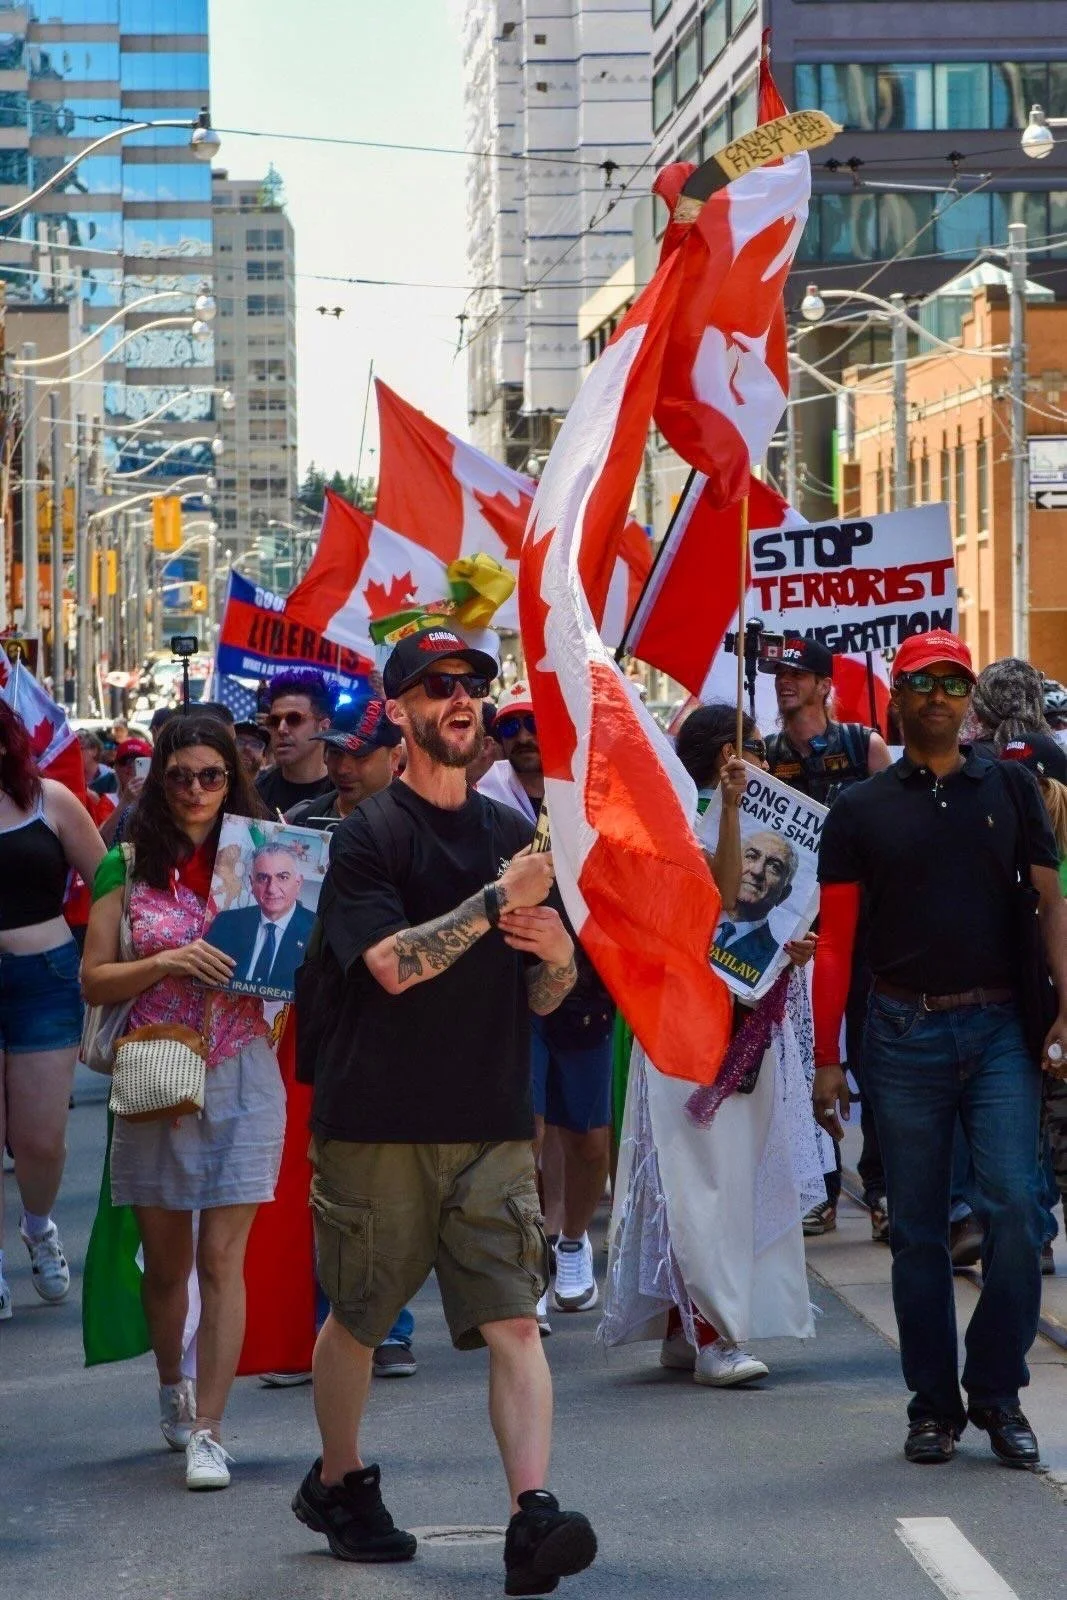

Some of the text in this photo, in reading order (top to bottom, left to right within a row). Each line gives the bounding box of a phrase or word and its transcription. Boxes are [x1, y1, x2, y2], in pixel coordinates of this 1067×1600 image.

[724, 120, 792, 161] CANADA
[731, 137, 785, 173] FIRST
[753, 521, 873, 572] STOP
[753, 557, 955, 612] TERRORIST
[428, 631, 459, 643] CANADA
[739, 795, 784, 830] RAN'S
[746, 779, 824, 836] ONG LIV
[232, 981, 257, 993] IRAN
[259, 985, 294, 999] GREAT
